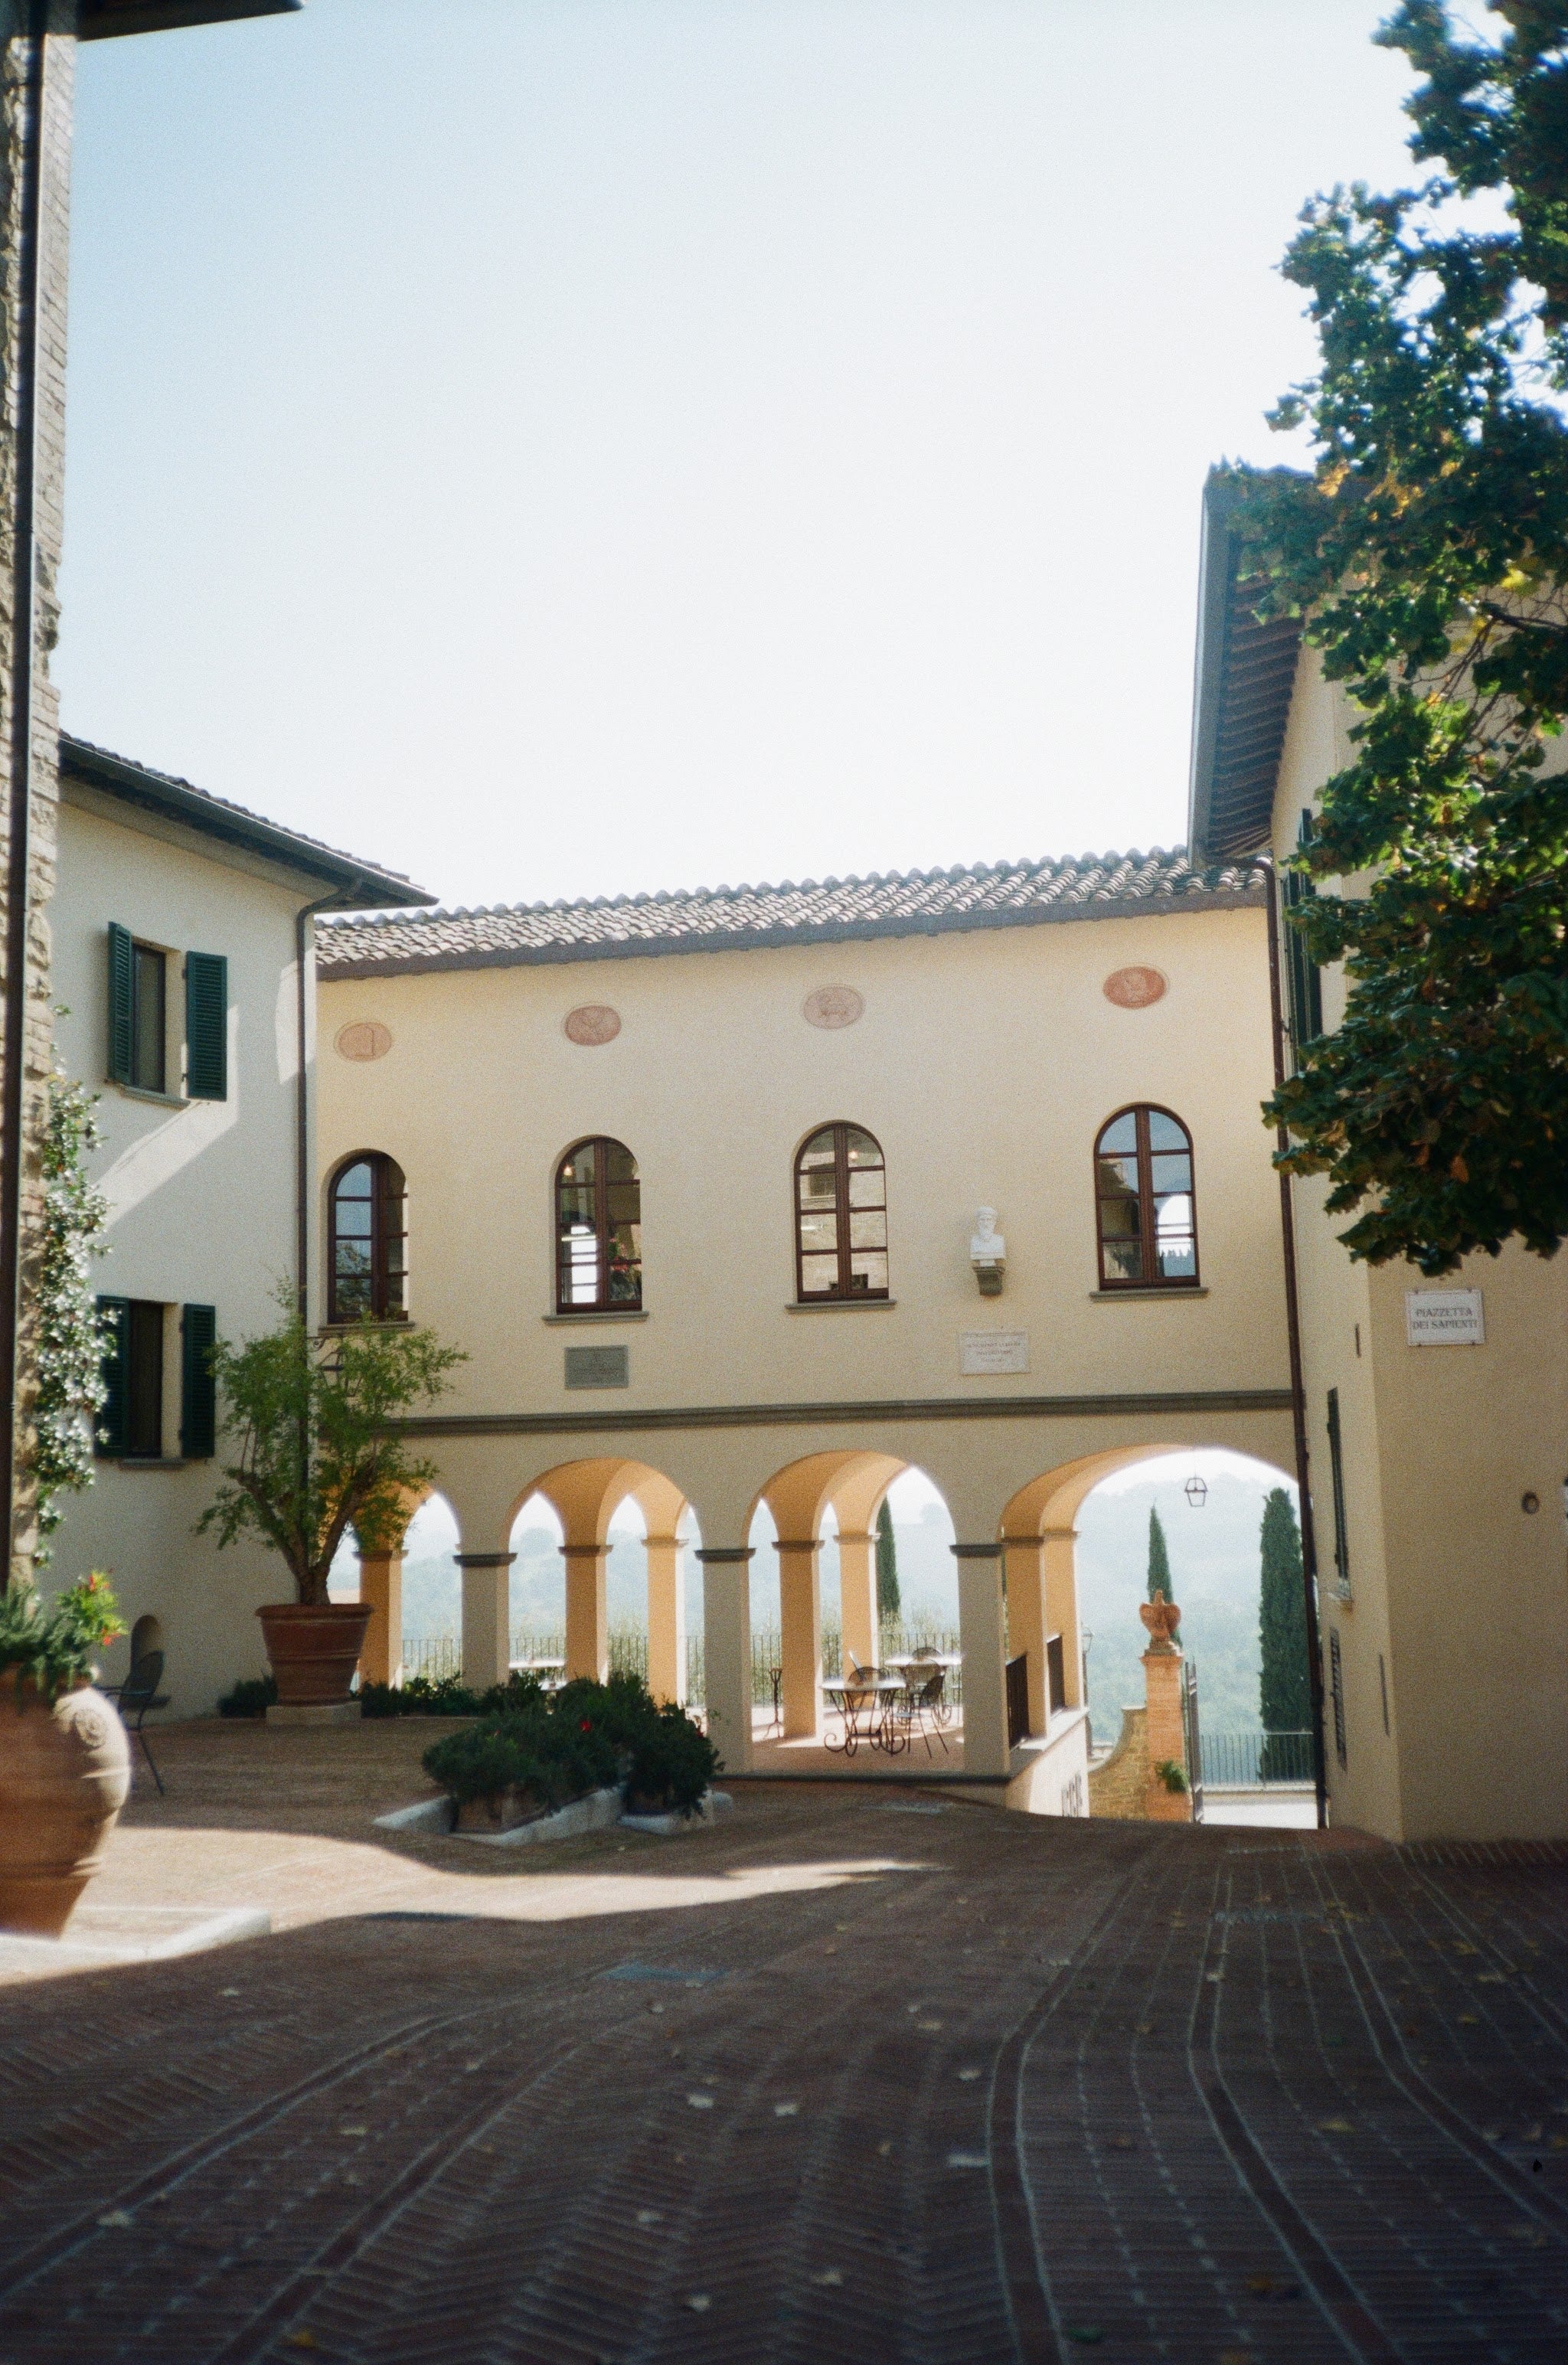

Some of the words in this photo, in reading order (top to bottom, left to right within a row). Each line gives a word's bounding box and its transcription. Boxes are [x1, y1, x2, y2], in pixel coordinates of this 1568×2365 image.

[1415, 1308, 1473, 1317] PIAZZETTA
[1412, 1321, 1429, 1330] DEI
[1431, 1319, 1478, 1329] SAPIENTI
